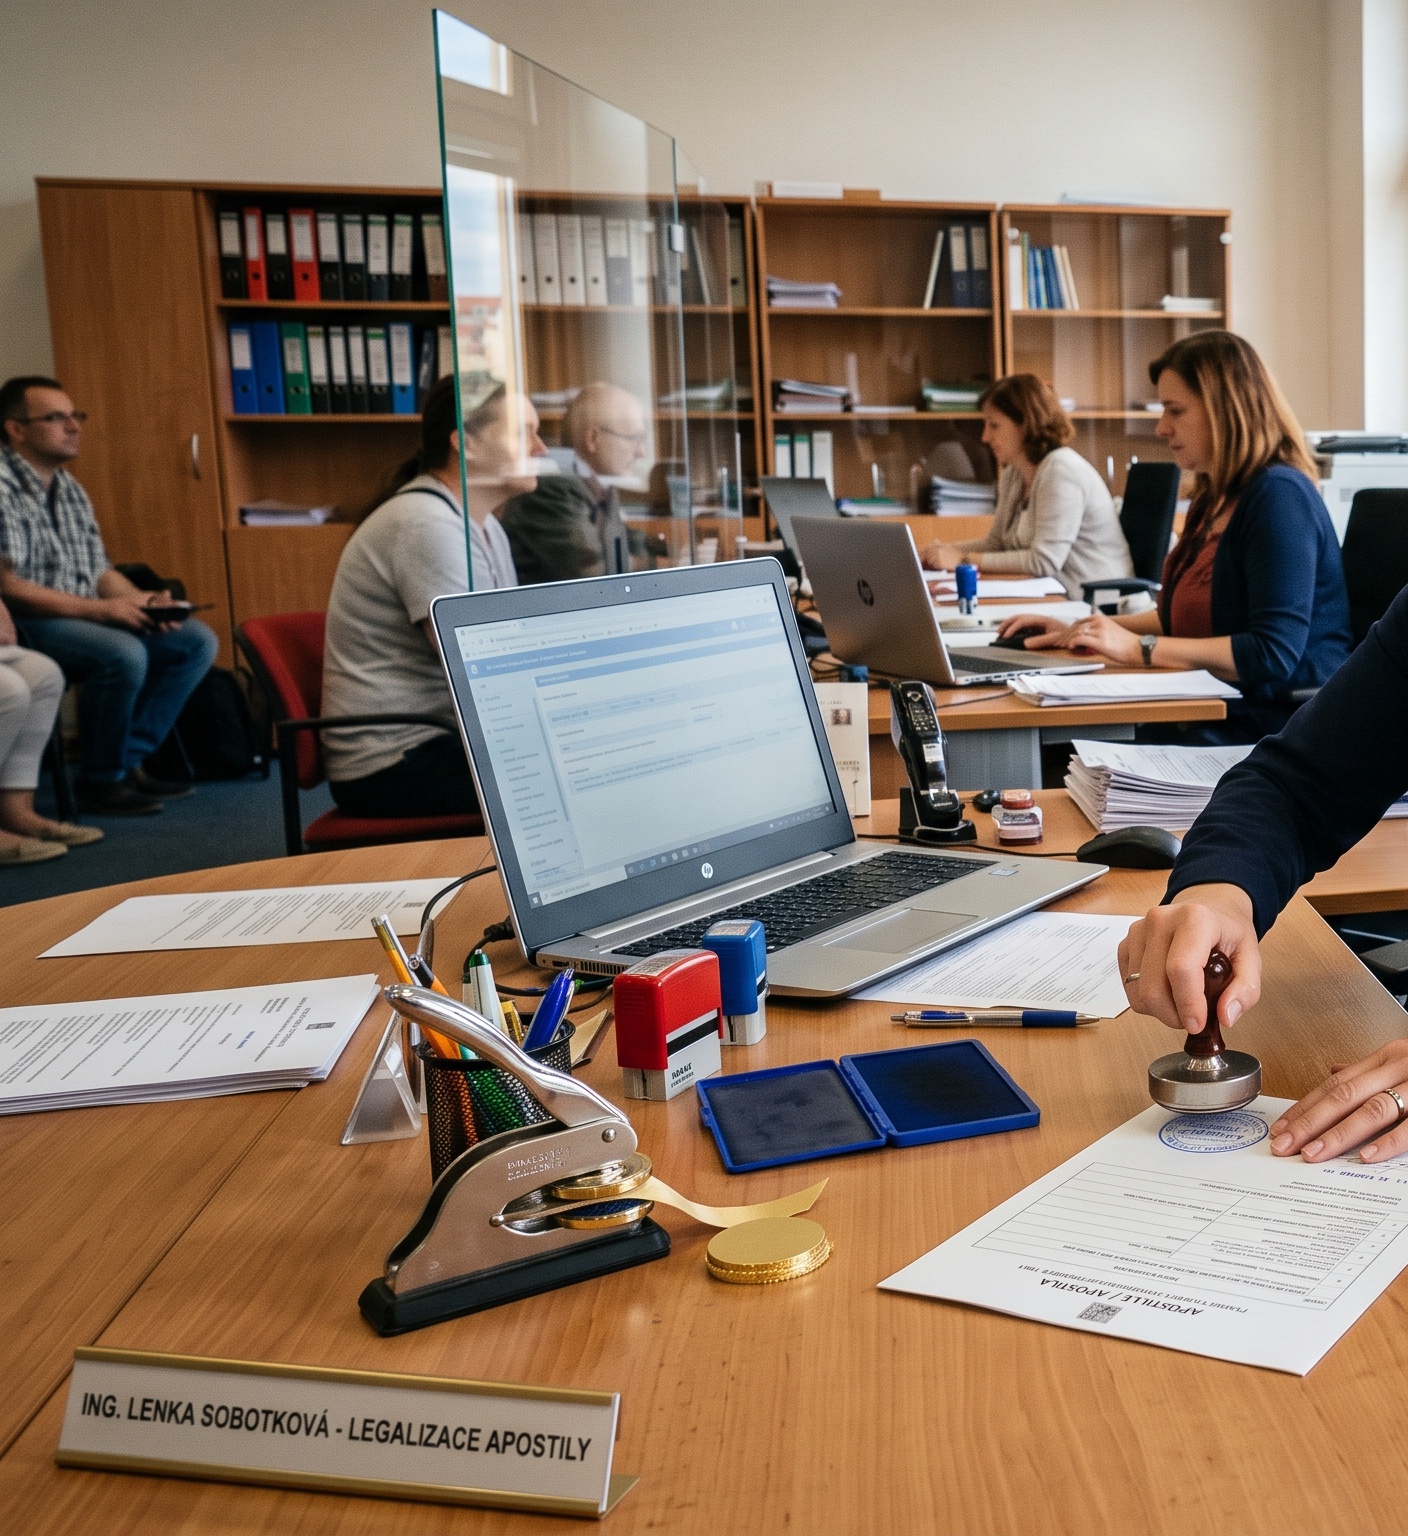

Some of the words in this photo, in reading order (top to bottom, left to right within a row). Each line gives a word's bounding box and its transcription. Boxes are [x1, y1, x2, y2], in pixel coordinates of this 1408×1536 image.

[1040, 1278, 1111, 1297] APOSTILA
[1108, 1291, 1123, 1301] /
[1121, 1293, 1205, 1316] APOSTILLE
[81, 1393, 121, 1419] ING.
[127, 1398, 195, 1426] LENKA
[200, 1403, 330, 1439] SOBOTKOVÁ
[348, 1418, 482, 1452] LEGALIZACE
[485, 1429, 592, 1462] APOSTILY
